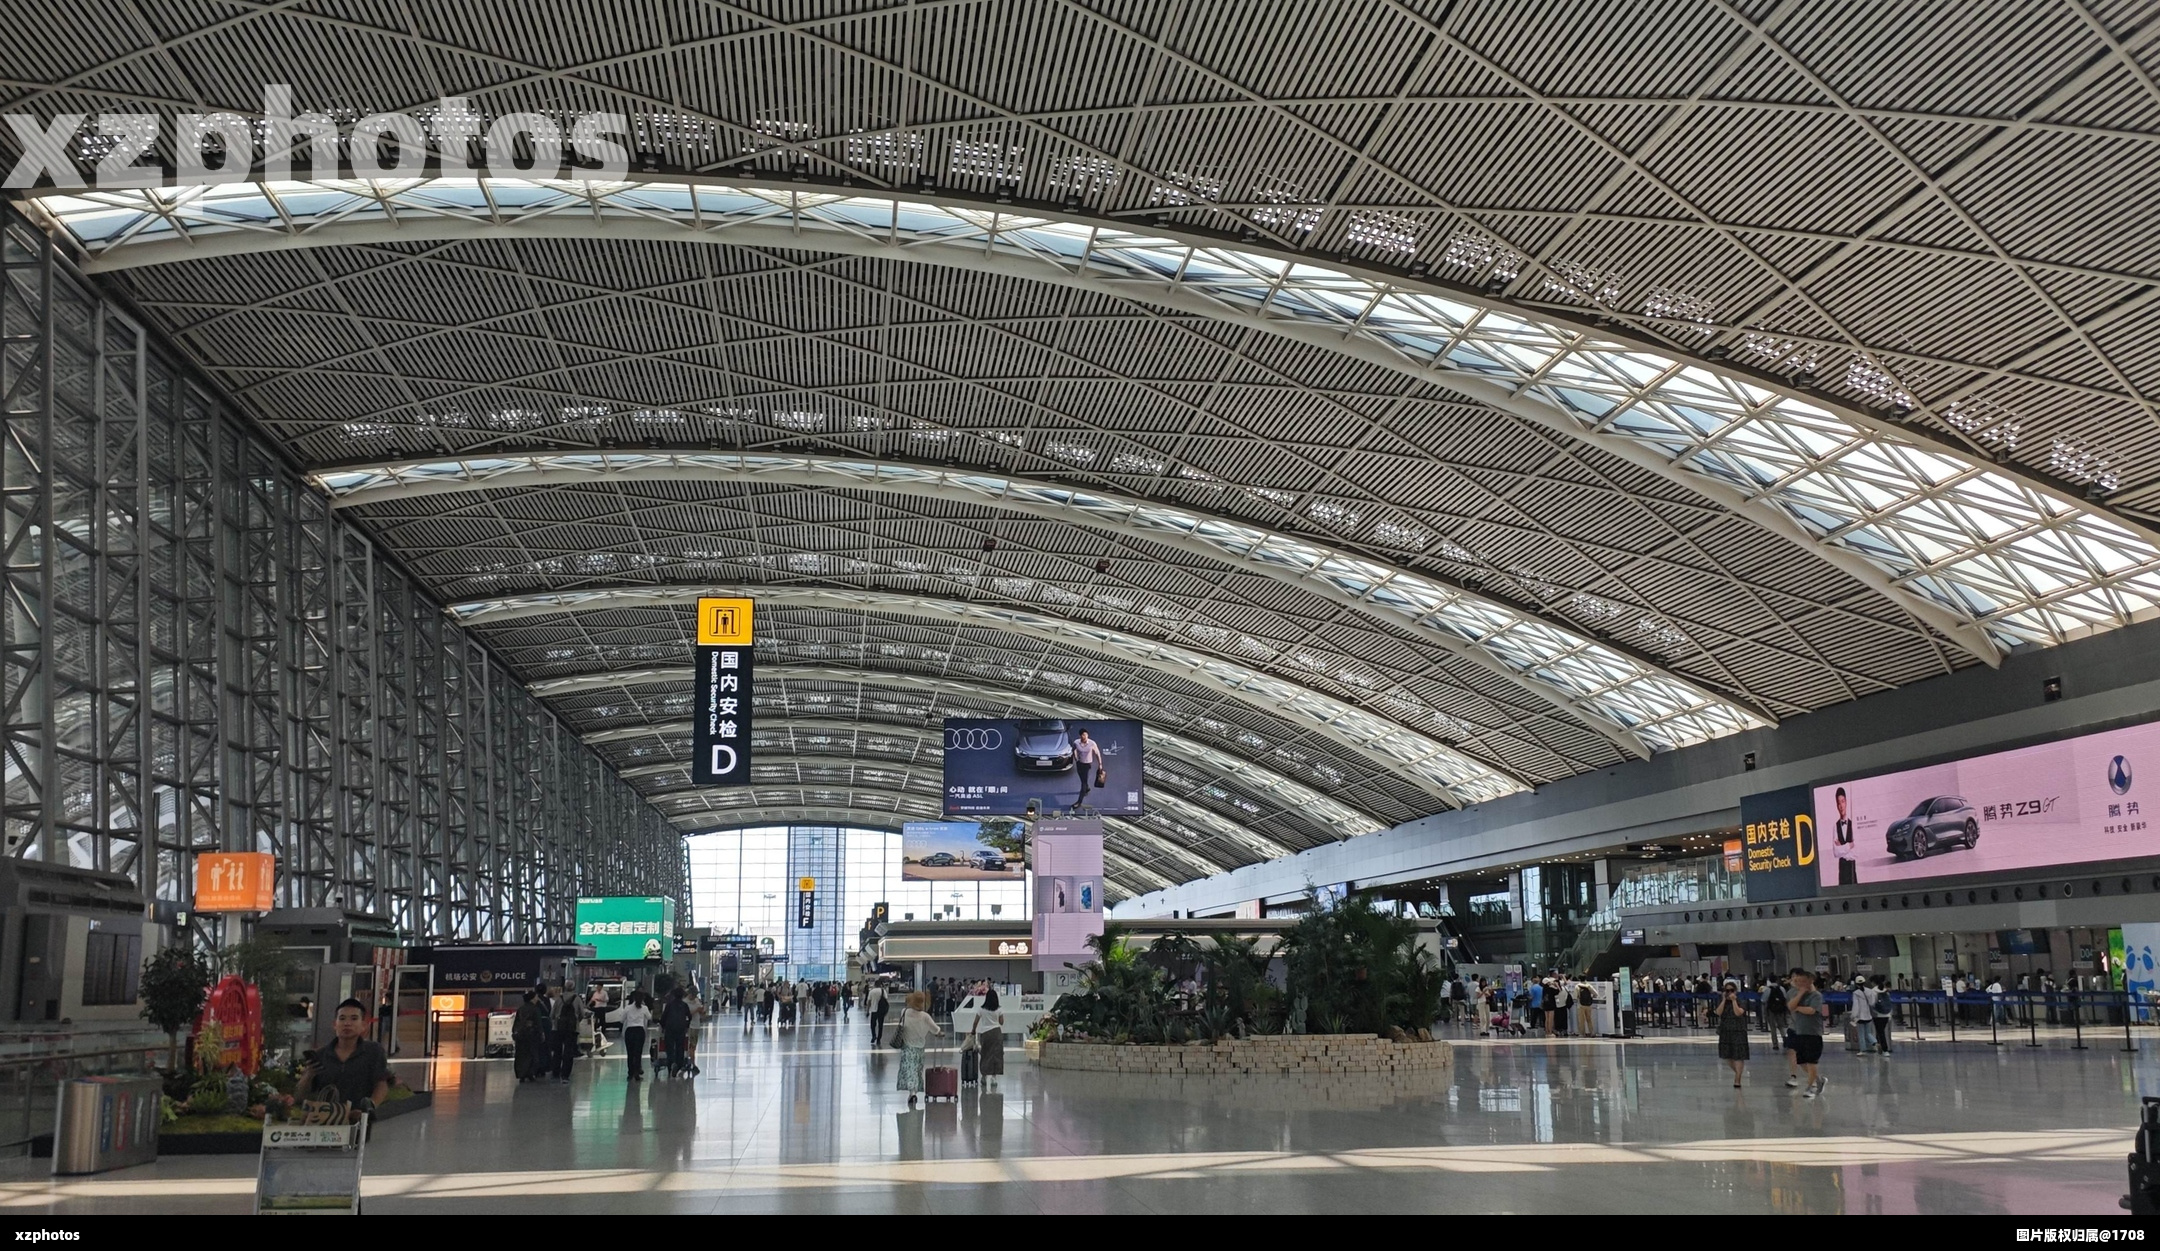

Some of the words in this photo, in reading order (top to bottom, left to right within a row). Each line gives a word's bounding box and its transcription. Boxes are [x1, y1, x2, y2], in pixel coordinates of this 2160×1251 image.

[711, 651, 719, 683] Domestic
[708, 684, 718, 713] Security
[719, 651, 738, 738] 国内安检
[709, 713, 718, 735] Check
[711, 744, 737, 775] D
[1746, 817, 1791, 845] 国内安检
[1795, 814, 1815, 866] D
[1747, 845, 1775, 860] Domestic
[1749, 859, 1772, 872] Security
[1772, 855, 1791, 868] Check
[876, 906, 885, 918] P
[579, 921, 660, 935] 全友全屋定制
[802, 917, 809, 927] F
[445, 973, 477, 981] 机场公安
[495, 972, 526, 980] POLICE
